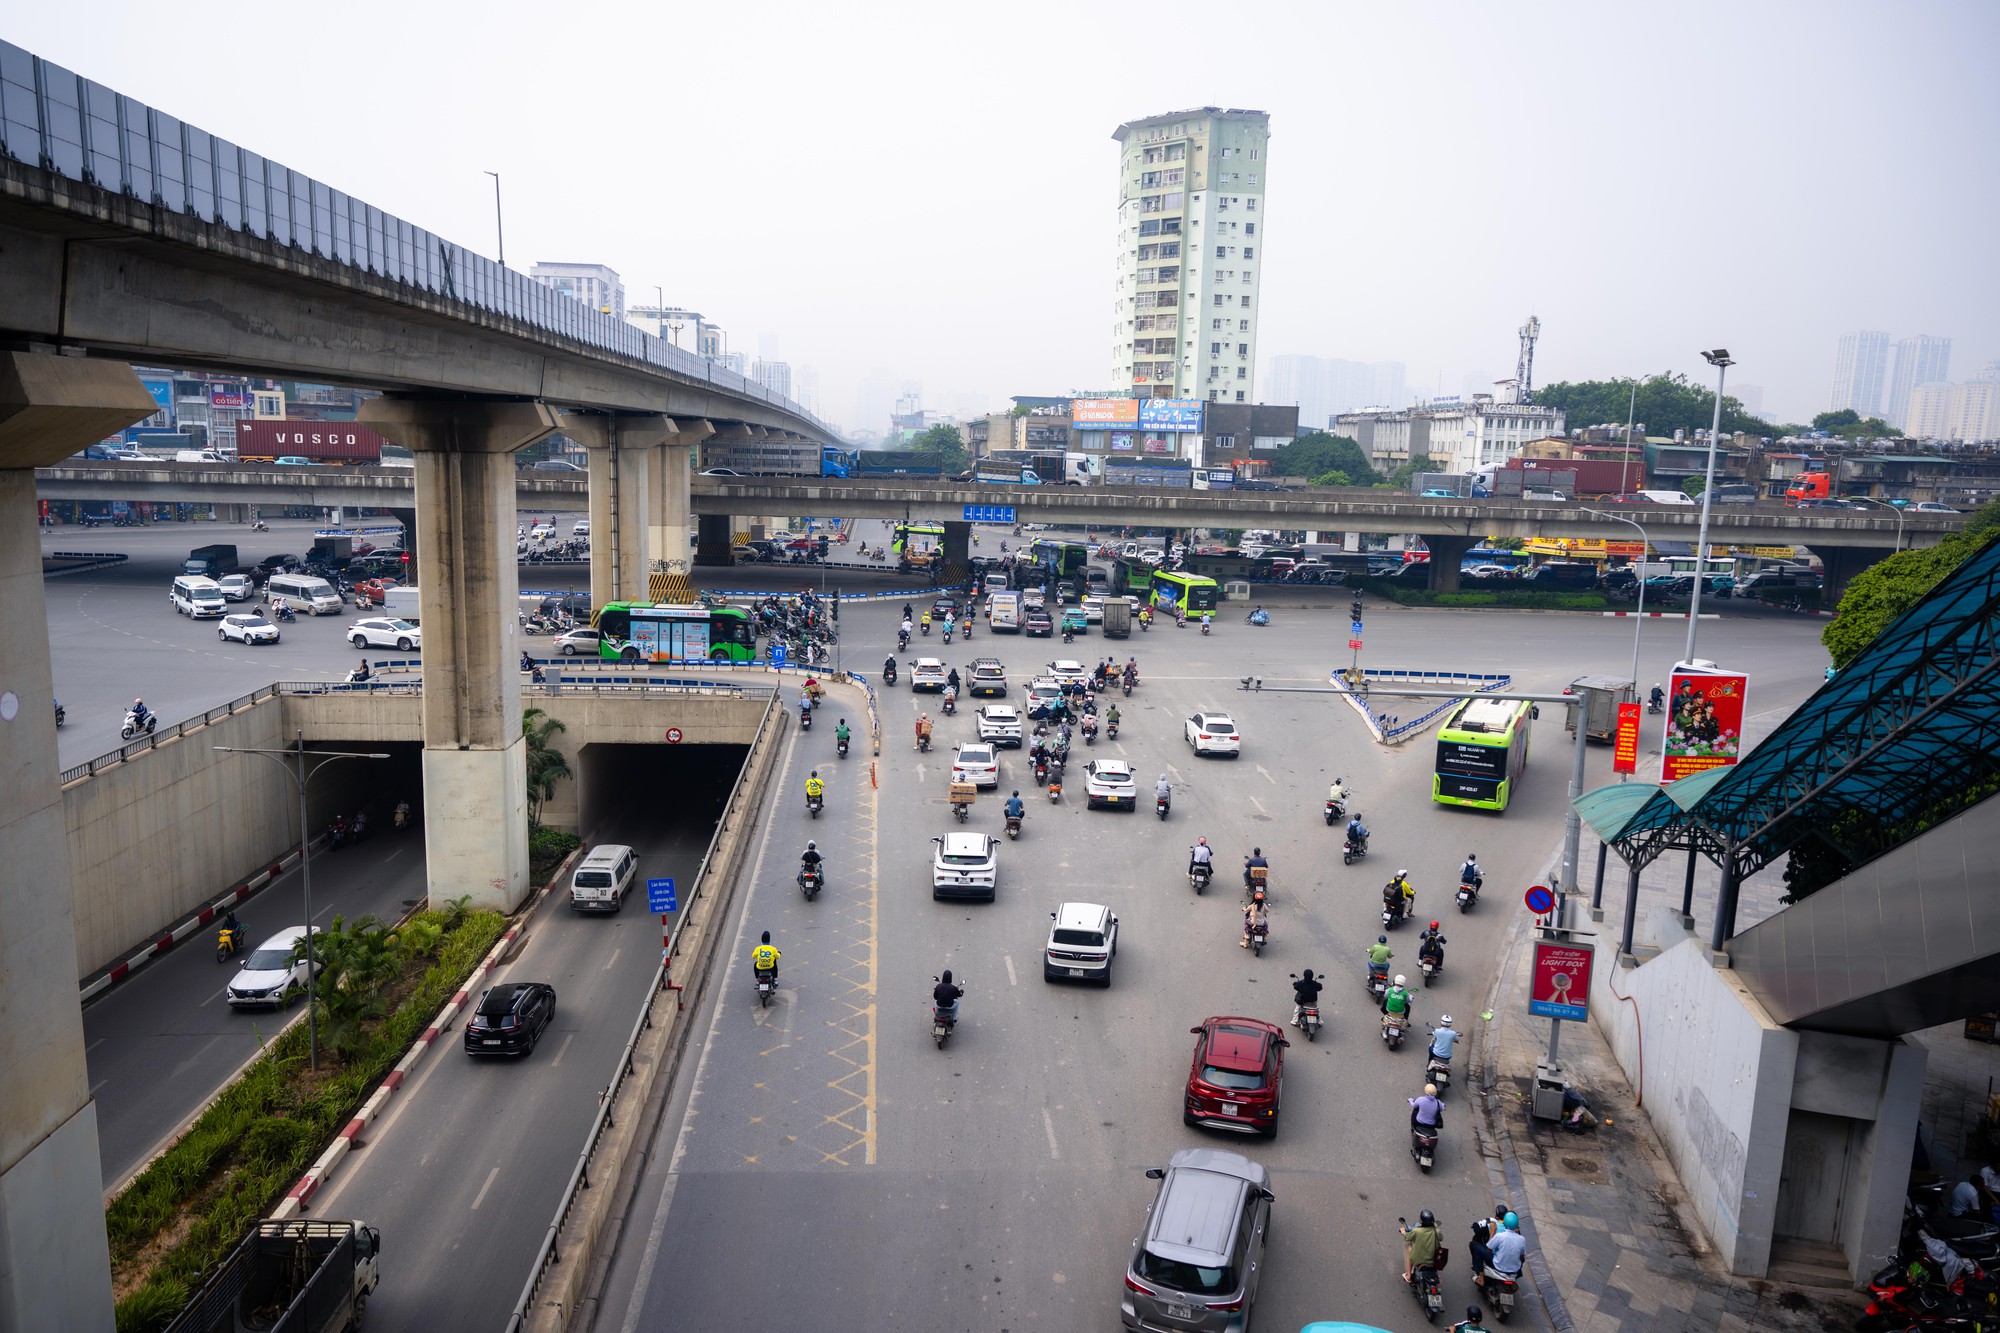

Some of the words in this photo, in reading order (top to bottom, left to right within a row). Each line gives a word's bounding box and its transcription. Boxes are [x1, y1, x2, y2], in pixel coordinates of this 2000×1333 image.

[216, 396, 226, 404] có
[1154, 400, 1166, 408] SP
[1482, 404, 1546, 415] NACENTECH
[276, 432, 356, 445] VOSCO
[760, 948, 771, 958] be
